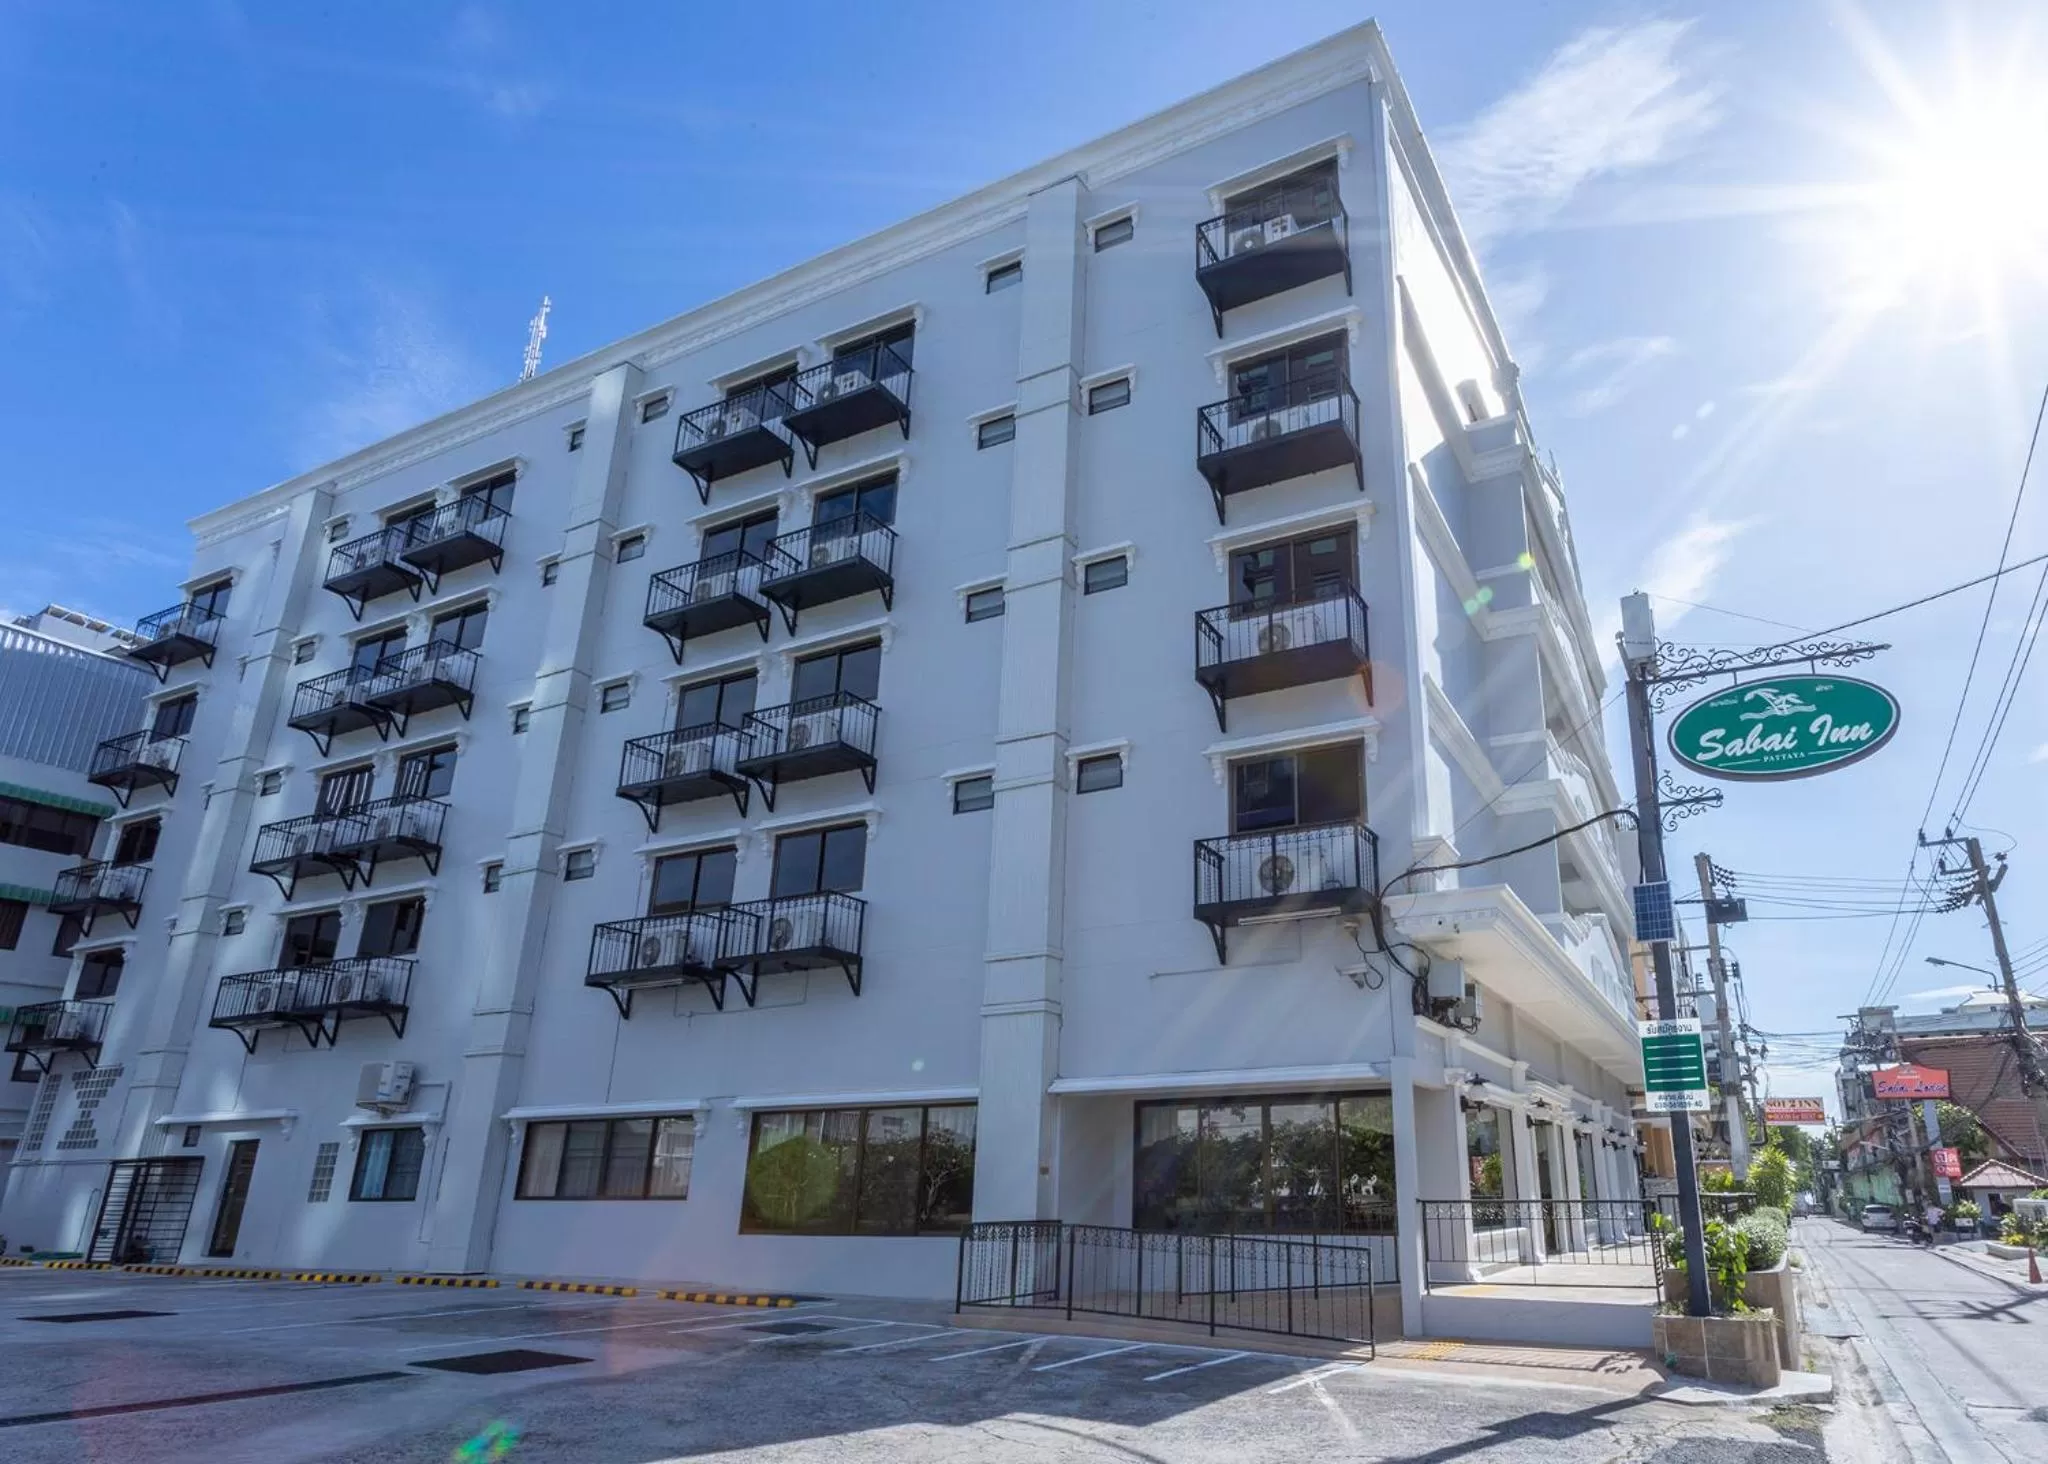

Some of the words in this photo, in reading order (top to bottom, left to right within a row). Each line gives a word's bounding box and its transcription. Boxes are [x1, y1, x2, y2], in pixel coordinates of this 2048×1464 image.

[1696, 723, 1798, 761] Sabai
[1809, 713, 1874, 746] Inn
[1762, 751, 1806, 763] PATTAYA
